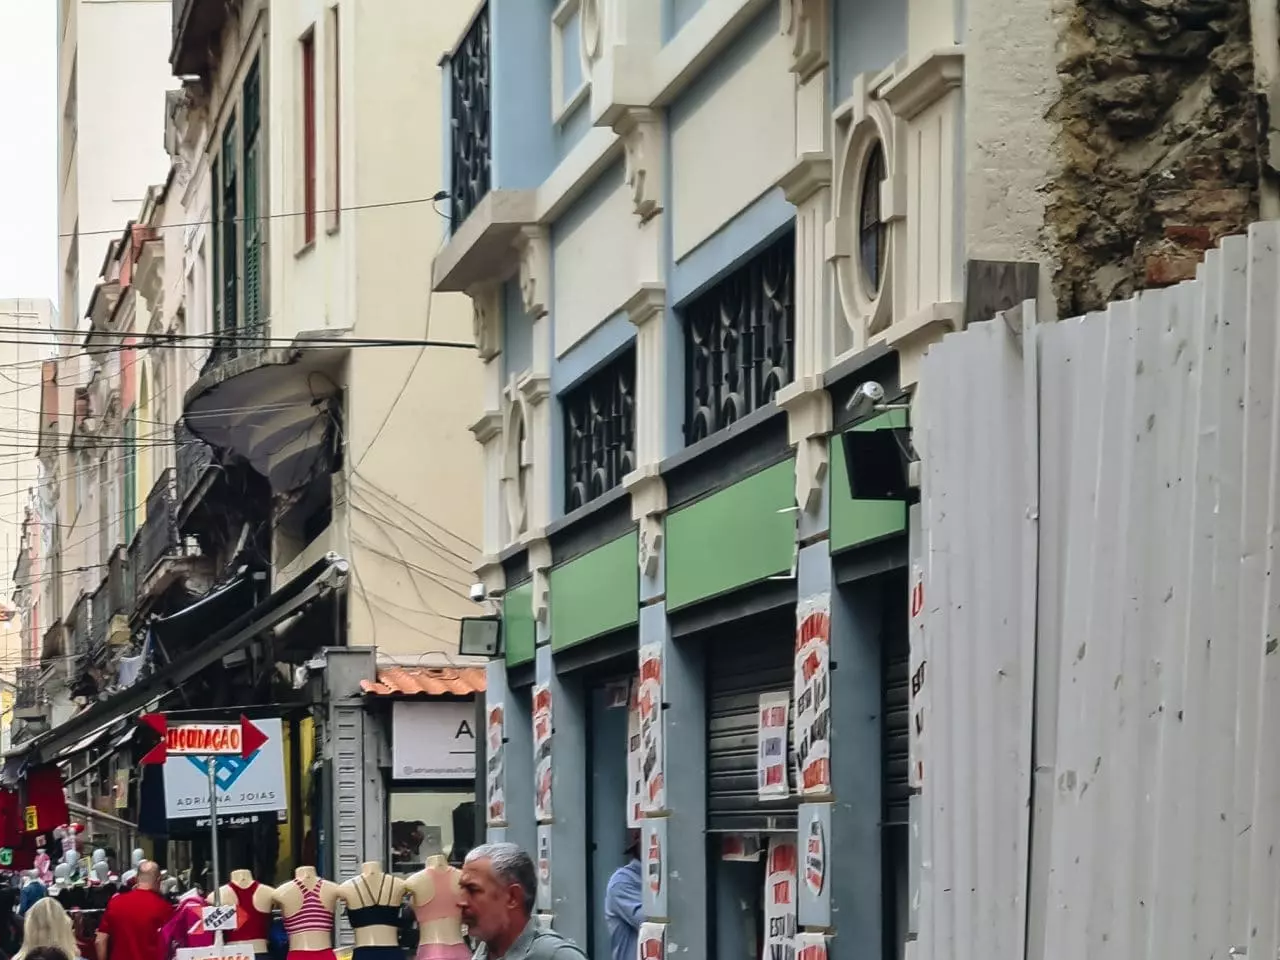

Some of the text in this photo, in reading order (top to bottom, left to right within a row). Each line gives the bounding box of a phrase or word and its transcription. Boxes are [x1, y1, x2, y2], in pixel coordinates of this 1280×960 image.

[455, 719, 475, 739] A
[240, 791, 276, 802] JOIAS
[230, 816, 250, 825] Loja
